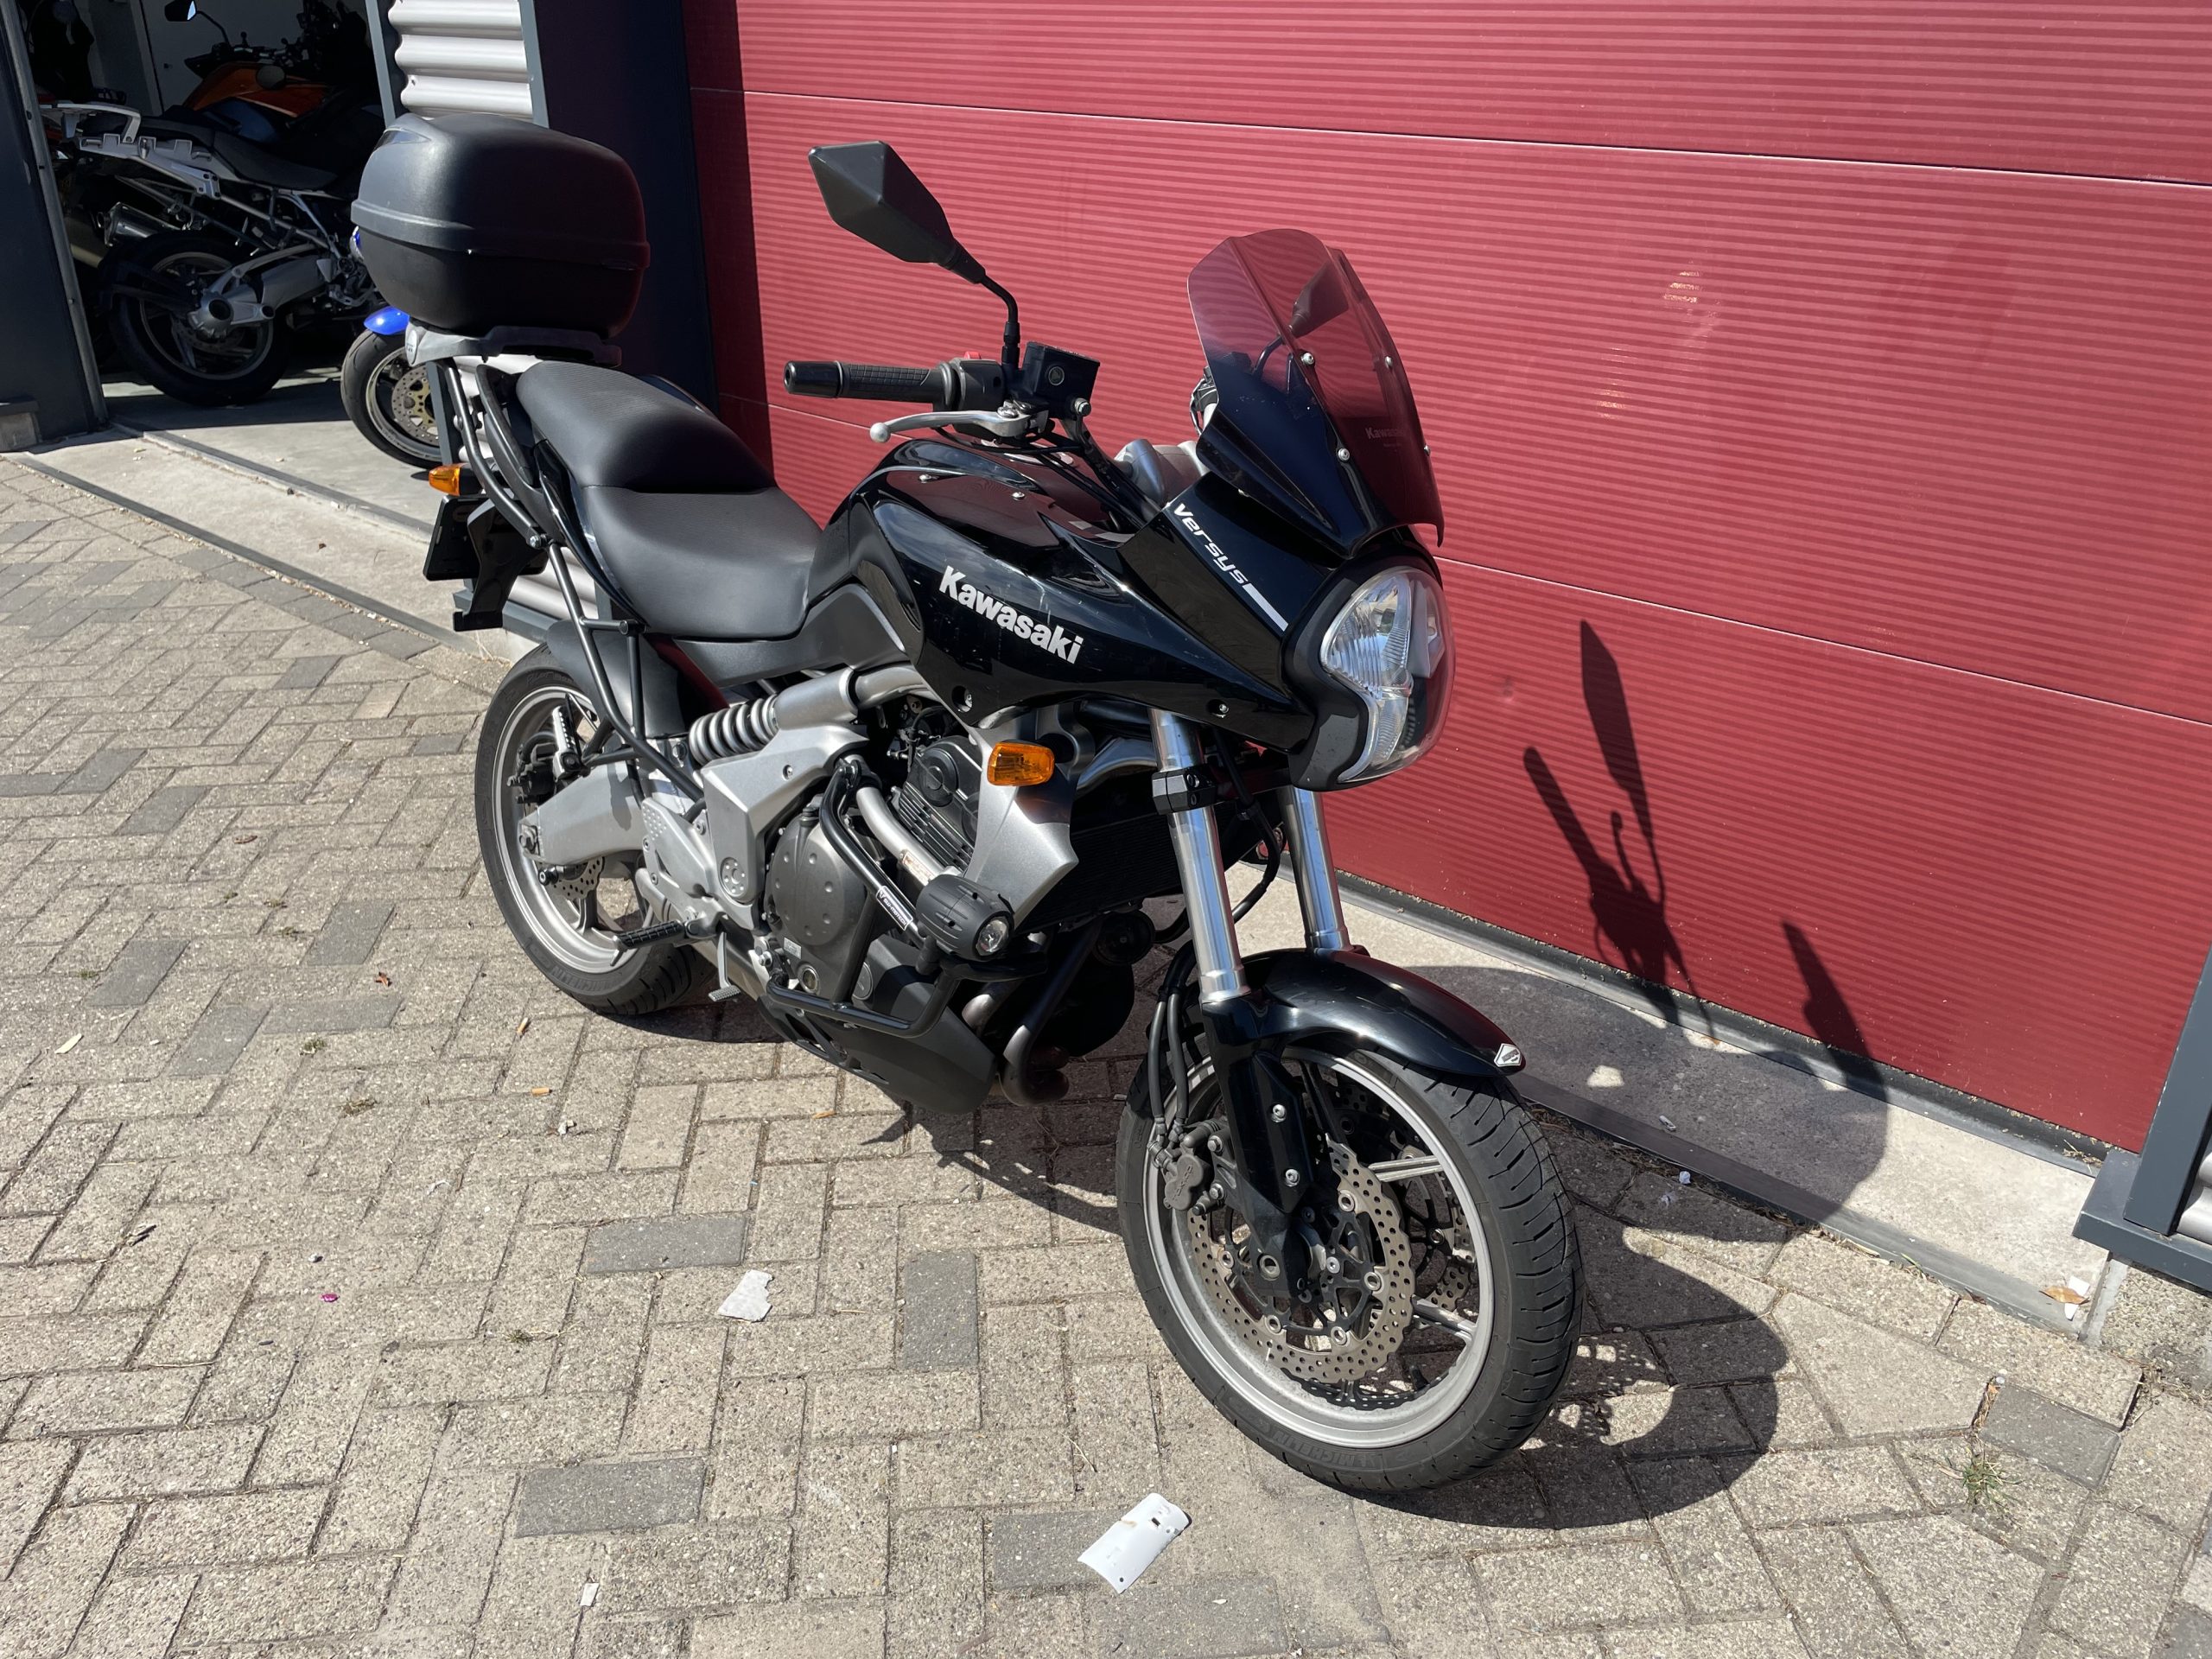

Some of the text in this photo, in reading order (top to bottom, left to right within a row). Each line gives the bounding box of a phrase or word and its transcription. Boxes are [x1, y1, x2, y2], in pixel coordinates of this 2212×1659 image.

[1173, 503, 1249, 584] Versys
[938, 565, 1084, 664] Kawasaki
[1271, 1431, 1355, 1466] MICHELIN
